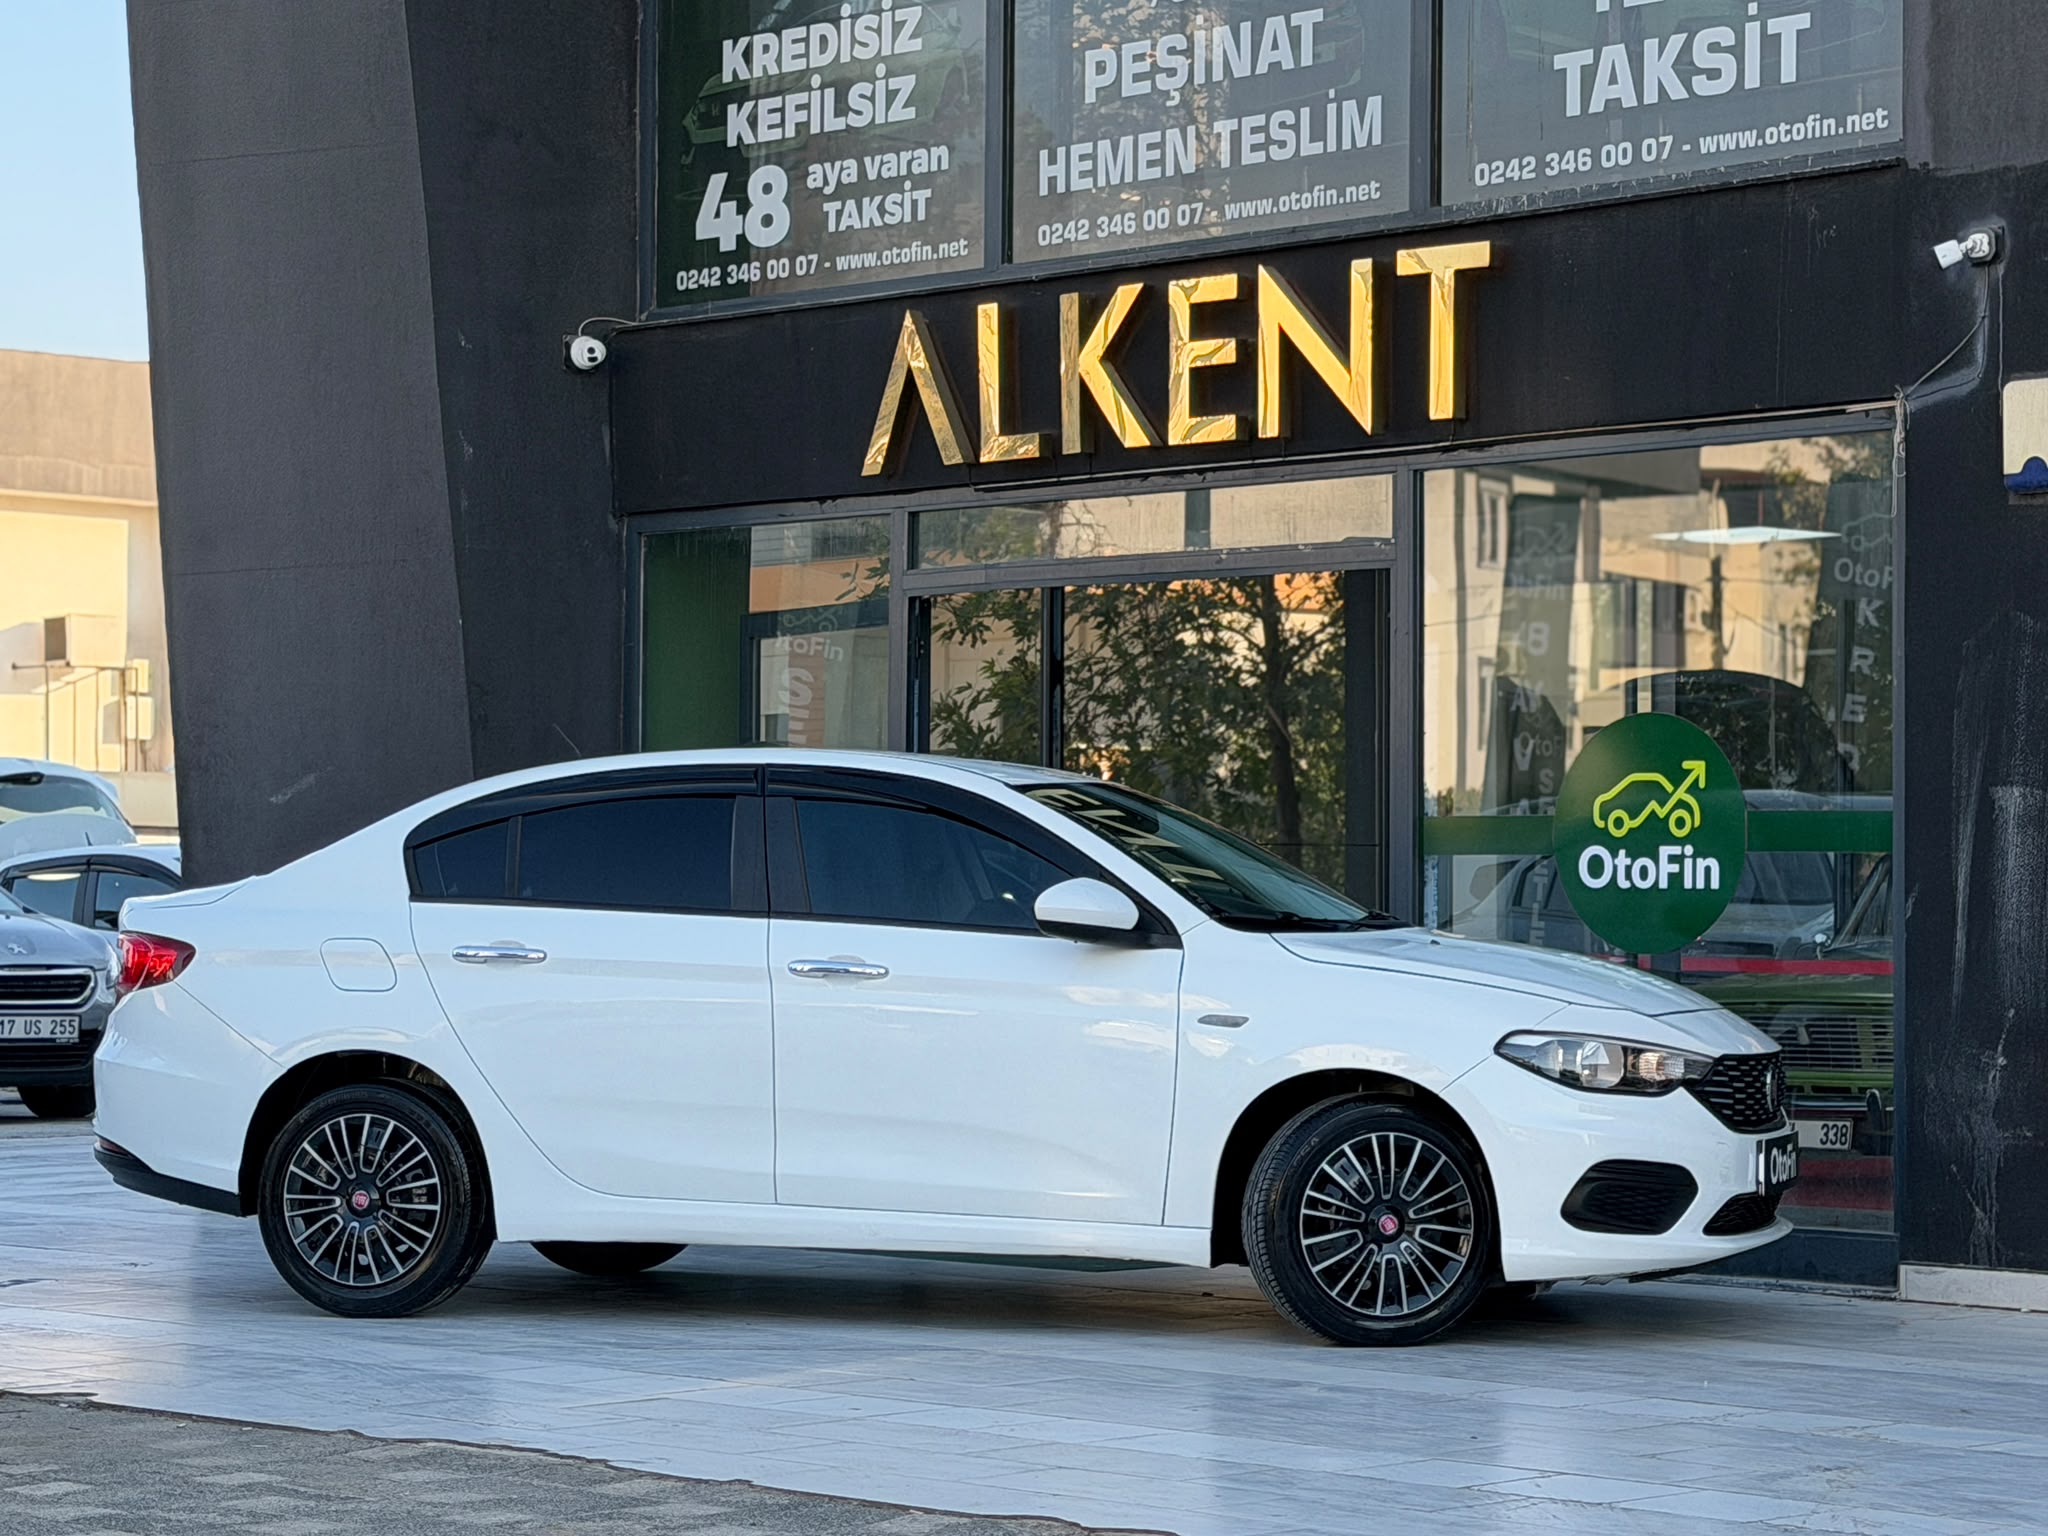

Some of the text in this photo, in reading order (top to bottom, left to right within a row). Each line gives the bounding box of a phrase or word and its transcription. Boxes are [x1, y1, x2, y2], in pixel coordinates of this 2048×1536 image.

[722, 0, 922, 83] KREDİSİZ
[1084, 8, 1324, 106] PEŞİNAT
[1553, 2, 1811, 118] TAKSİT
[726, 63, 917, 148] KEFİLSİZ
[806, 144, 950, 196] aya varan
[1039, 89, 1383, 197] HEMEN TESLİM
[1474, 157, 1536, 187] 0242
[1545, 148, 1592, 178] 346
[1601, 142, 1633, 169] 00
[1641, 135, 1674, 163] 07
[1699, 107, 1889, 155] www.otofin.net
[695, 164, 791, 252] 48
[823, 180, 932, 233] TAKSİT
[1037, 219, 1089, 247] 0242
[1096, 212, 1136, 238] 346
[1143, 207, 1170, 231] 00
[1176, 202, 1203, 227] 07
[1224, 180, 1381, 220] www.otofin.net
[676, 266, 722, 291] 0242
[726, 261, 761, 284] 346
[767, 258, 790, 281] 00
[795, 254, 819, 276] 07
[836, 238, 969, 271] www.otofin.net
[861, 241, 1491, 477] ALKENT
[1578, 843, 1721, 890] OtoFin
[24, 1019, 42, 1036] US
[49, 1019, 76, 1036] 255
[1770, 1143, 1797, 1185] OtoFin
[1820, 1123, 1848, 1146] 338
